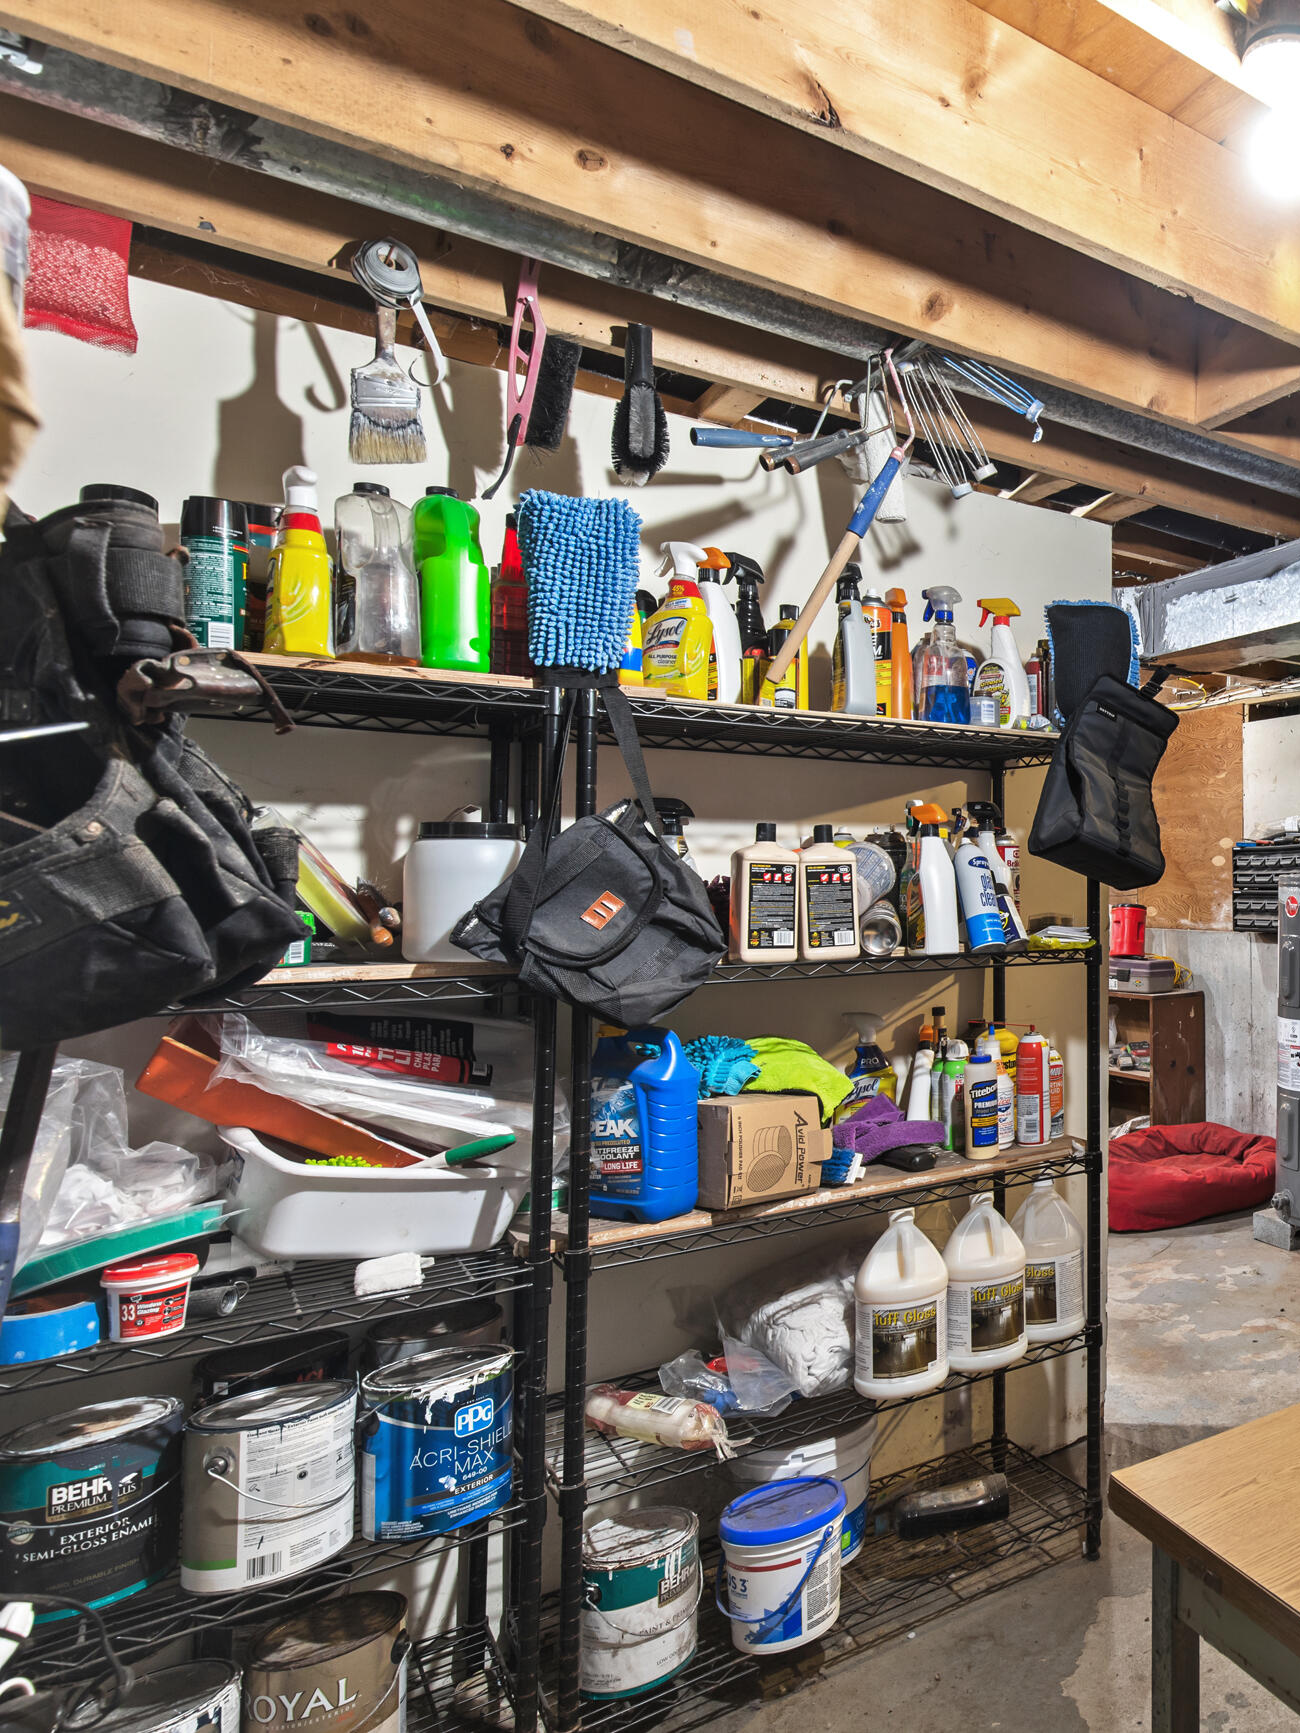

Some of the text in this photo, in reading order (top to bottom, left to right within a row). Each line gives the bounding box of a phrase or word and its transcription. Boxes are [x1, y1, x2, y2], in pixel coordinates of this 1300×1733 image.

[647, 620, 684, 644] Lysol
[860, 1057, 880, 1066] PRO
[970, 1083, 998, 1099] Titebo
[600, 1153, 636, 1161] OOLANT
[794, 1110, 809, 1185] Avid Power
[604, 1161, 639, 1171] LONG LIFE
[972, 1286, 997, 1302] Tuff
[121, 1304, 136, 1322] 33
[873, 1307, 937, 1327] Tuff Gloss
[457, 1404, 492, 1432] PPG
[454, 1447, 494, 1475] MAX
[462, 1466, 488, 1481] 649-00
[454, 1474, 494, 1495] EXTERIOR
[51, 1483, 137, 1516] PREMIUM LUS
[60, 1516, 131, 1546] EXTERIOR
[22, 1535, 108, 1563] SEMI-GLOSS
[660, 1567, 691, 1595] BEHR
[739, 1578, 748, 1593] 3
